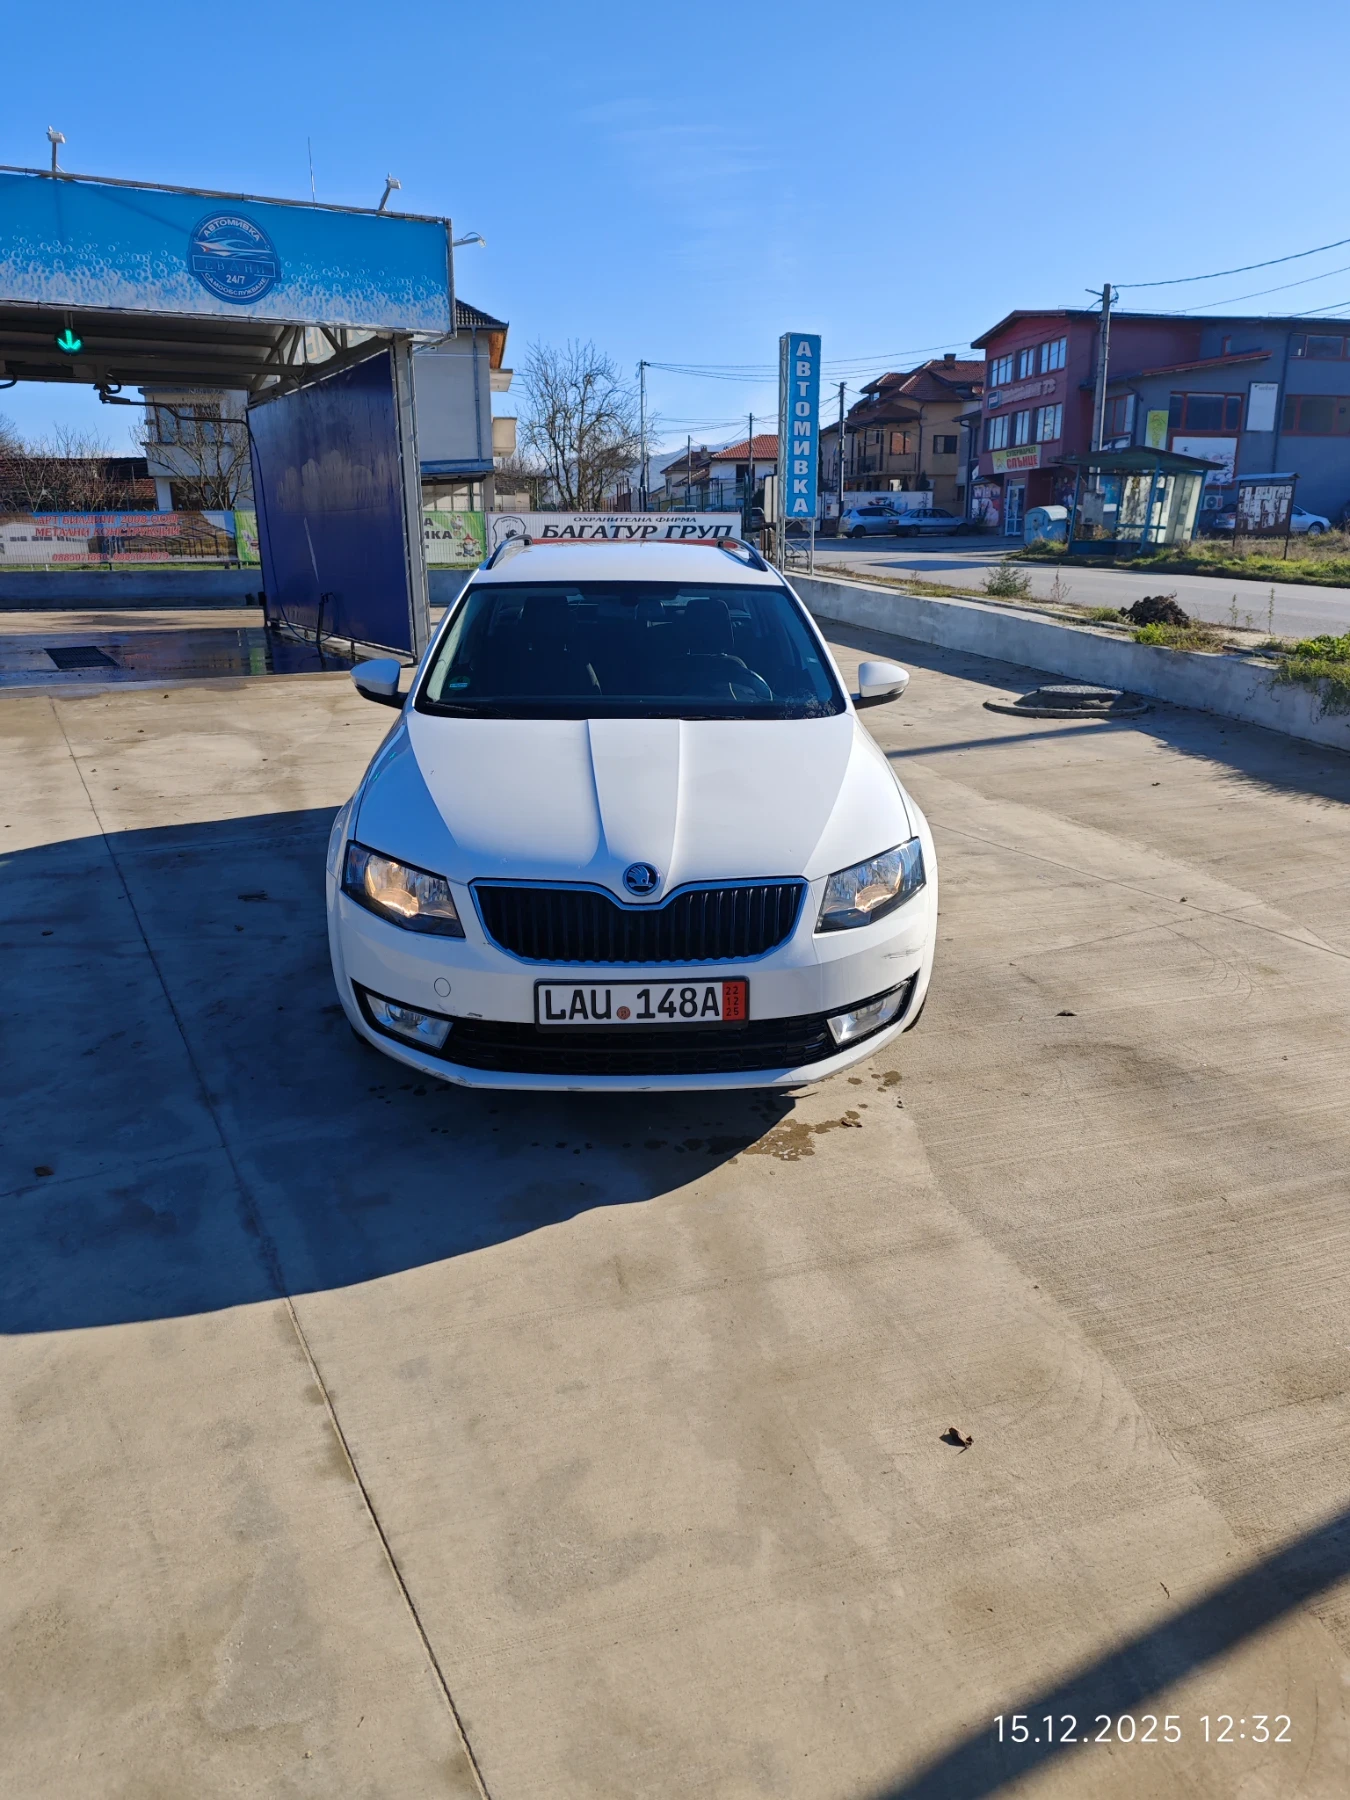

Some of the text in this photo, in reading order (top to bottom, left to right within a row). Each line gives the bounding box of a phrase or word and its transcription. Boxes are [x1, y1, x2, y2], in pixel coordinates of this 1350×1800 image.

[203, 219, 261, 241] АВТОМИВКА
[226, 274, 246, 285] 24/7
[793, 341, 813, 513] АВТОМИВКА
[1006, 446, 1037, 457] СУПЕРМАРКЕТ
[1006, 455, 1038, 469] СЛЪНЦЕ
[37, 515, 59, 525] АРТ
[35, 527, 91, 537] МЕТАЛНИ
[541, 525, 733, 539] БАГАТУР ГРУП
[725, 985, 739, 996] 22
[544, 986, 721, 1020] LAU 148A
[726, 996, 739, 1006] 12
[725, 1007, 740, 1017] 25
